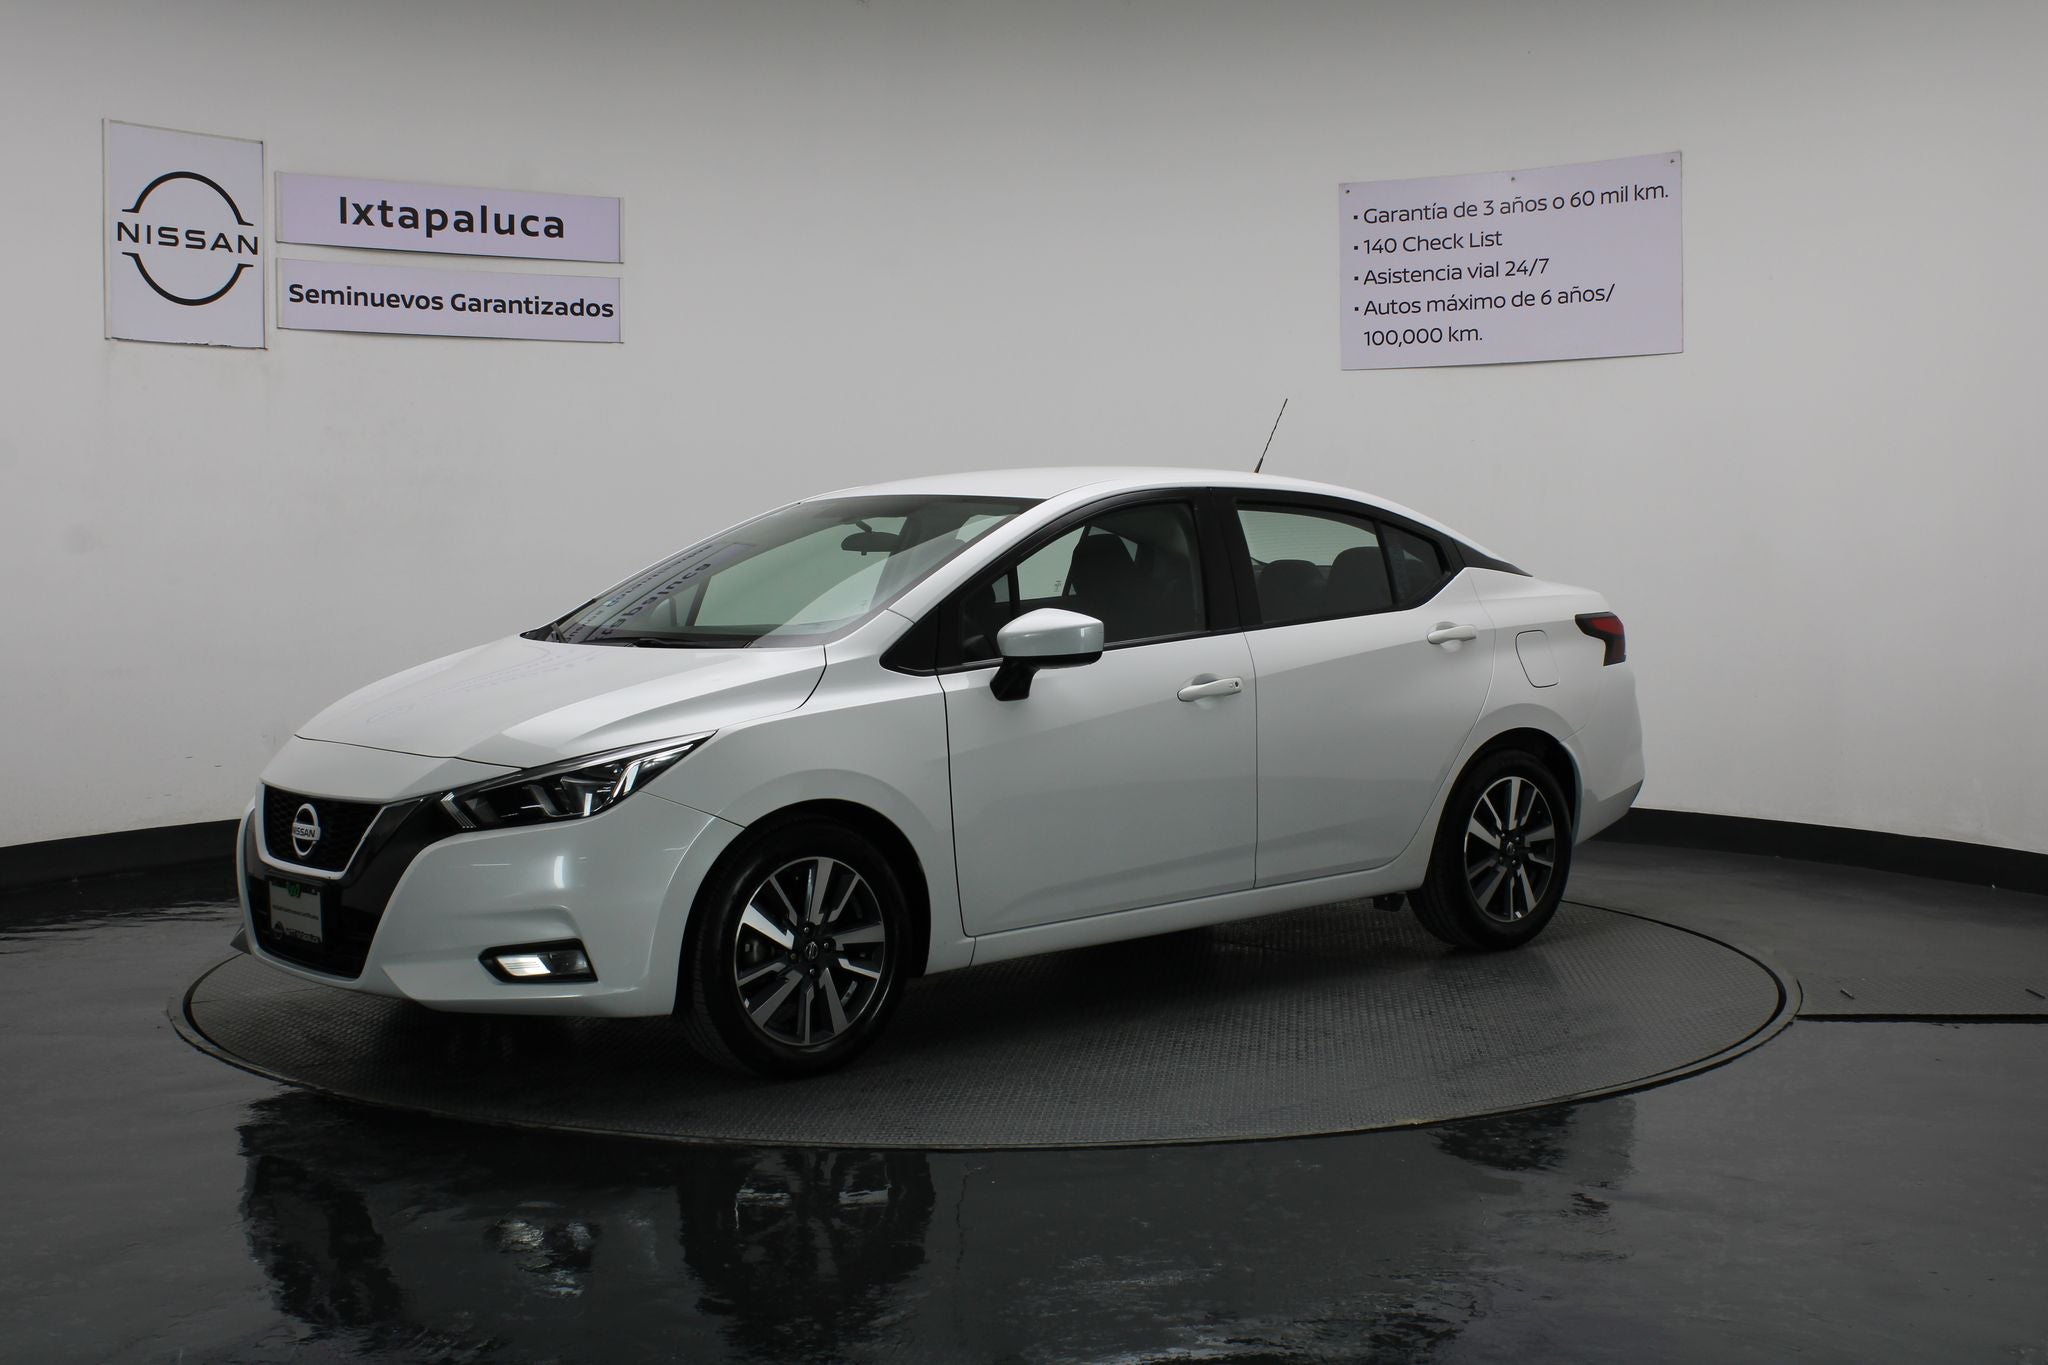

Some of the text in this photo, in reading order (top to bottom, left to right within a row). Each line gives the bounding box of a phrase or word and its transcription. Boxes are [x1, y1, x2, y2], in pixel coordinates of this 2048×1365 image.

[339, 196, 564, 239] Ixtapaluca
[1363, 184, 1669, 224] Garantía de 3 años o 60 mil km.
[117, 221, 259, 256] NISSAN
[1363, 230, 1503, 255] 140 Check List
[1363, 257, 1550, 286] Asistencia vial 24/7
[288, 283, 614, 318] Seminuevos Garantizados
[1363, 283, 1616, 316] Autos máximo de 6 años/
[1363, 325, 1483, 348] 100,000 km.
